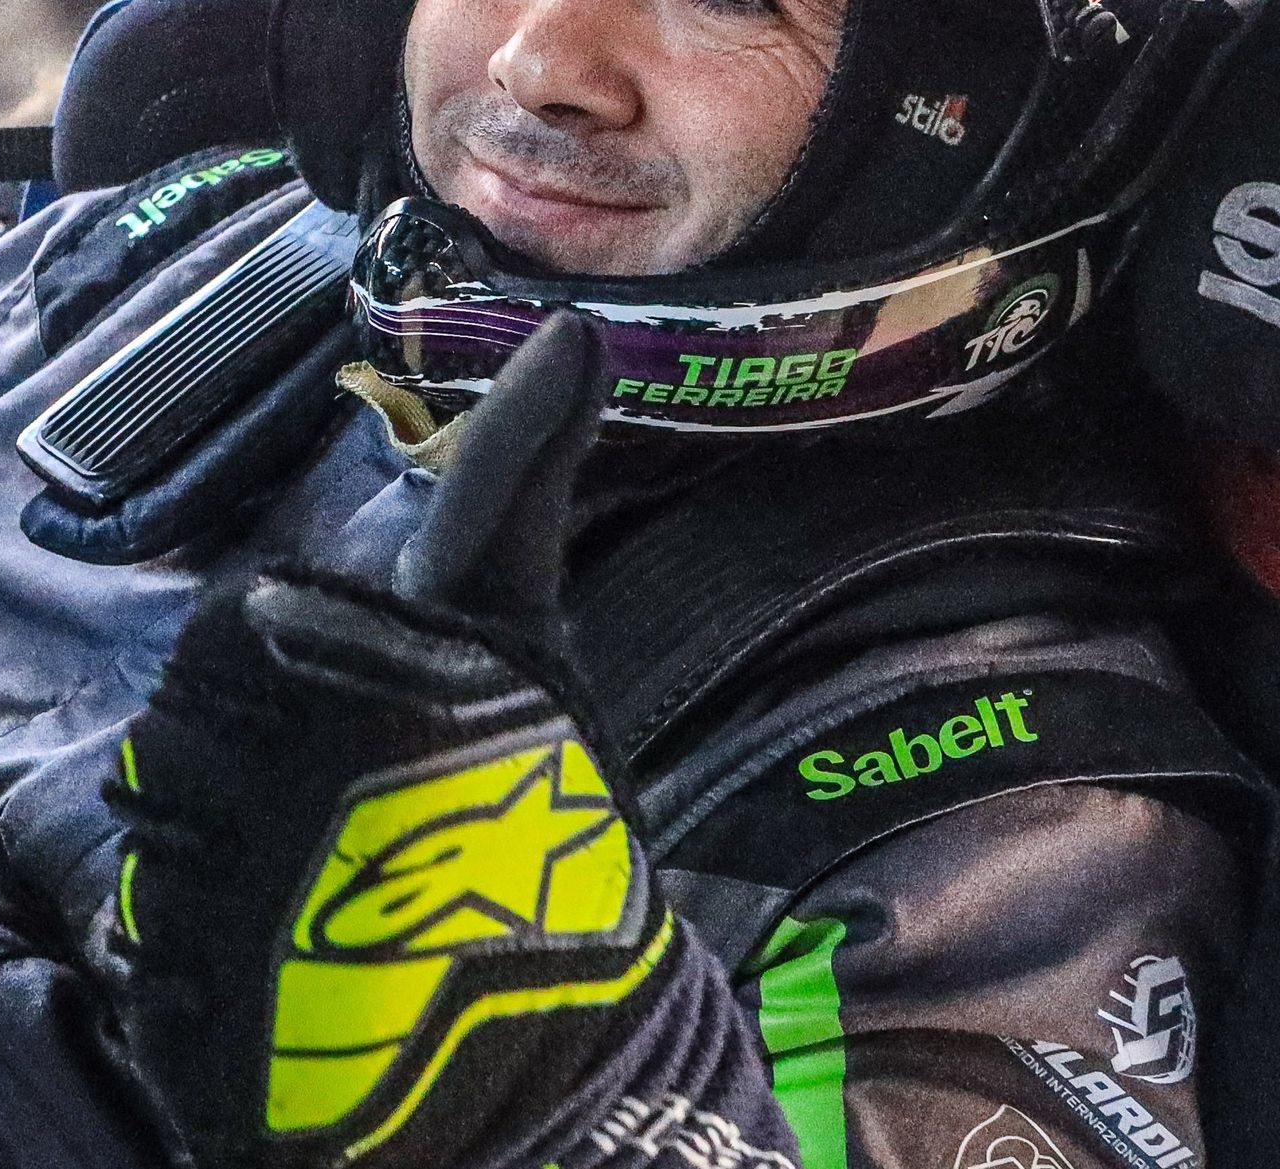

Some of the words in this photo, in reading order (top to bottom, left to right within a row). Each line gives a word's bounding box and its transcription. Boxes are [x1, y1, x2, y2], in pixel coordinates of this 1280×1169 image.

[894, 94, 966, 146] Stilo
[115, 148, 284, 240] Sabelt
[613, 378, 847, 407] FERREIRA
[678, 348, 858, 388] TIAGO
[799, 691, 1039, 801] Sabelt
[1046, 1076, 1152, 1169] INTERNAZIONA
